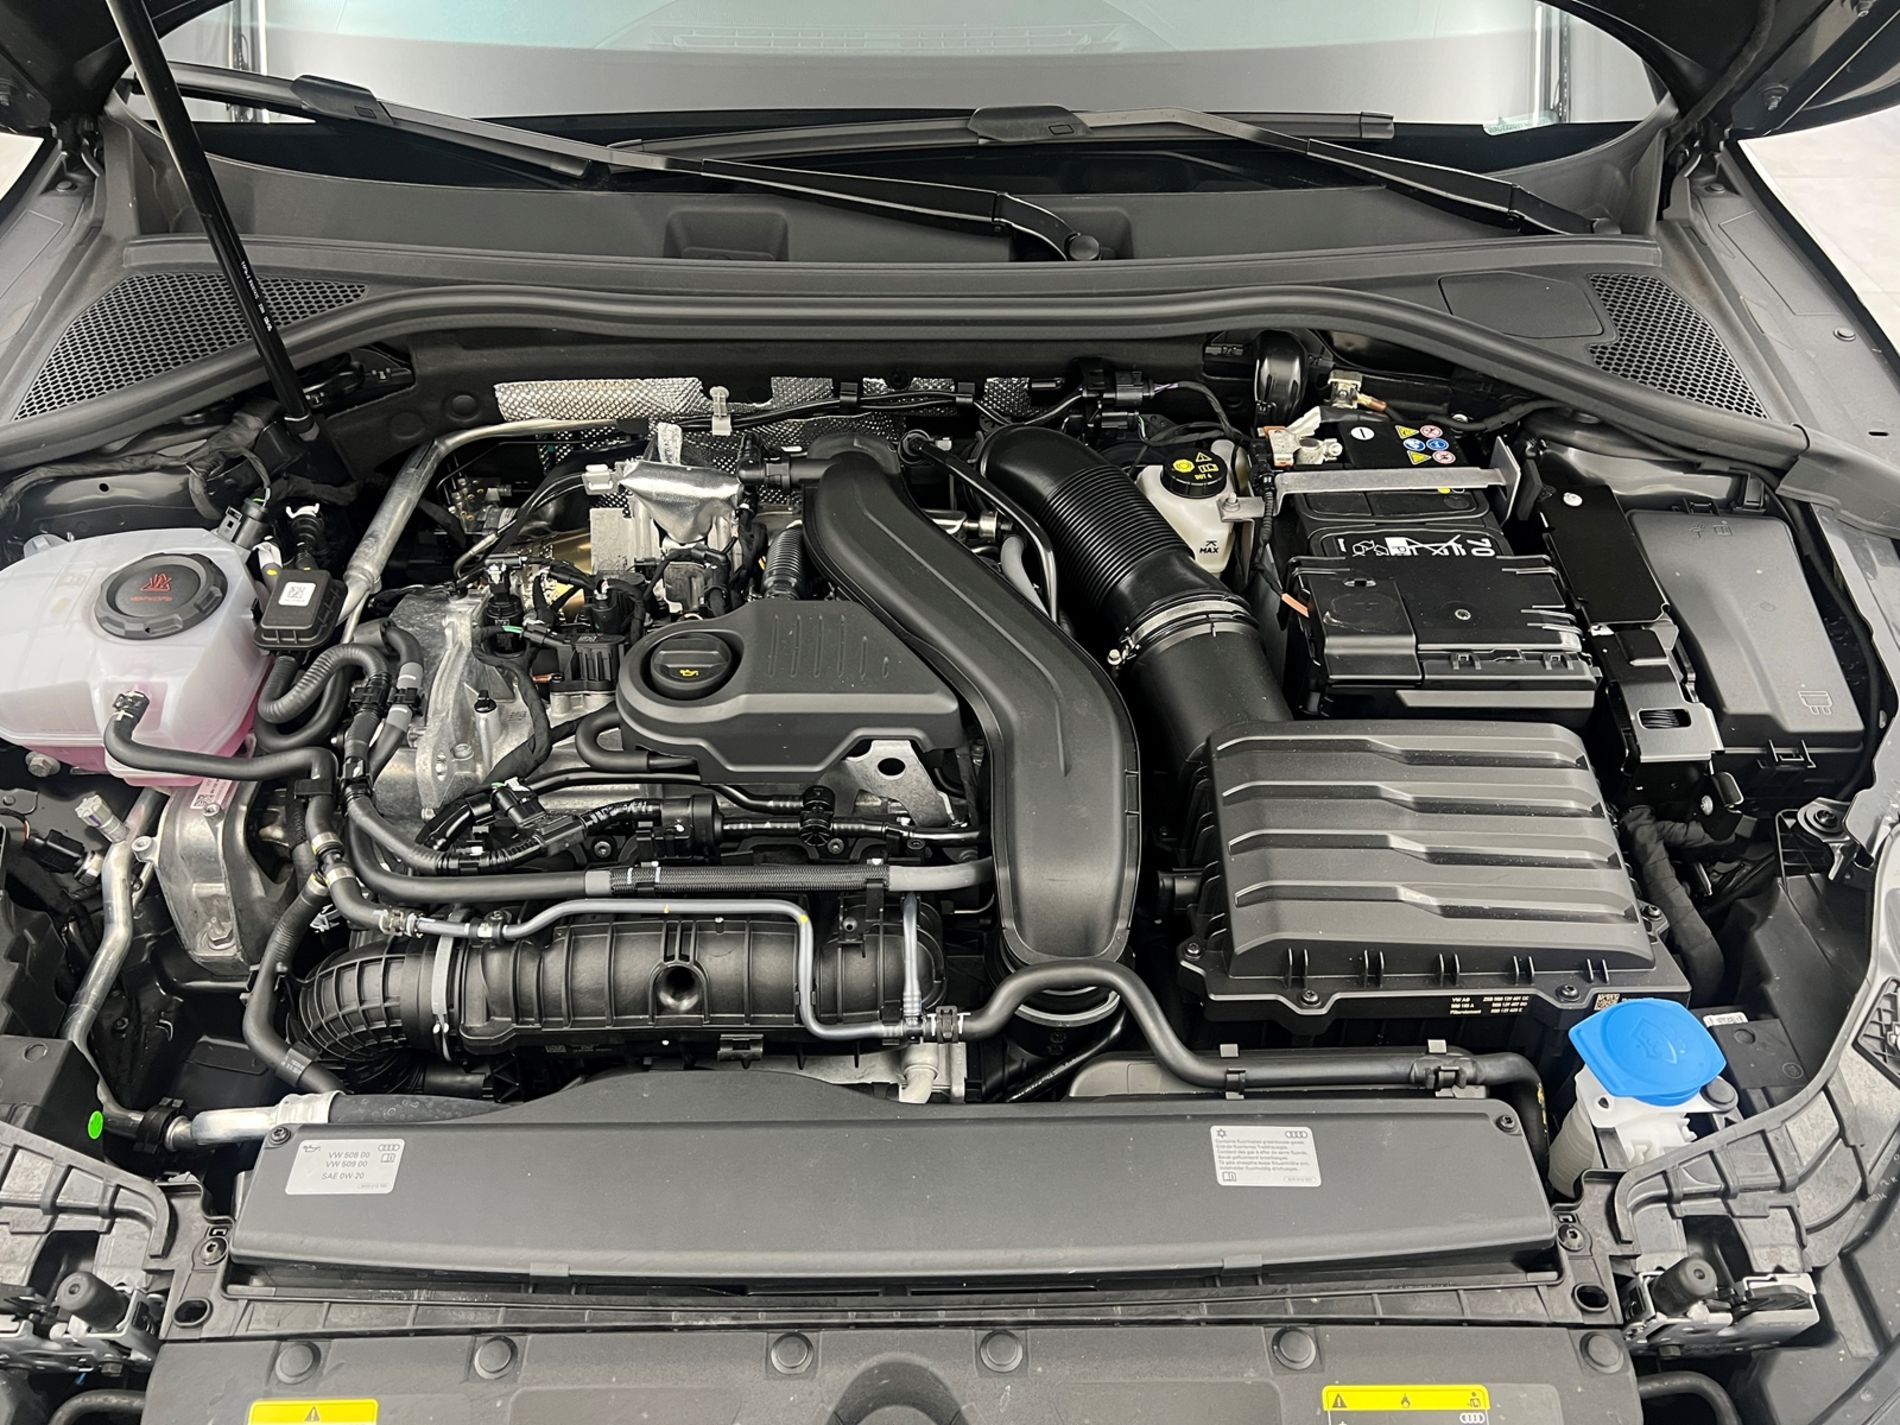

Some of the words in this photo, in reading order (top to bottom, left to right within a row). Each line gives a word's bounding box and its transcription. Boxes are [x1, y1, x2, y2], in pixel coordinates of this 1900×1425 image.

[1466, 538, 1496, 557] 70
[329, 1151, 343, 1159] VW
[360, 1151, 371, 1159] 00
[326, 1160, 341, 1168] VW
[357, 1160, 368, 1168] 00
[321, 1172, 338, 1180] SAE
[340, 1172, 365, 1180] 0W-20
